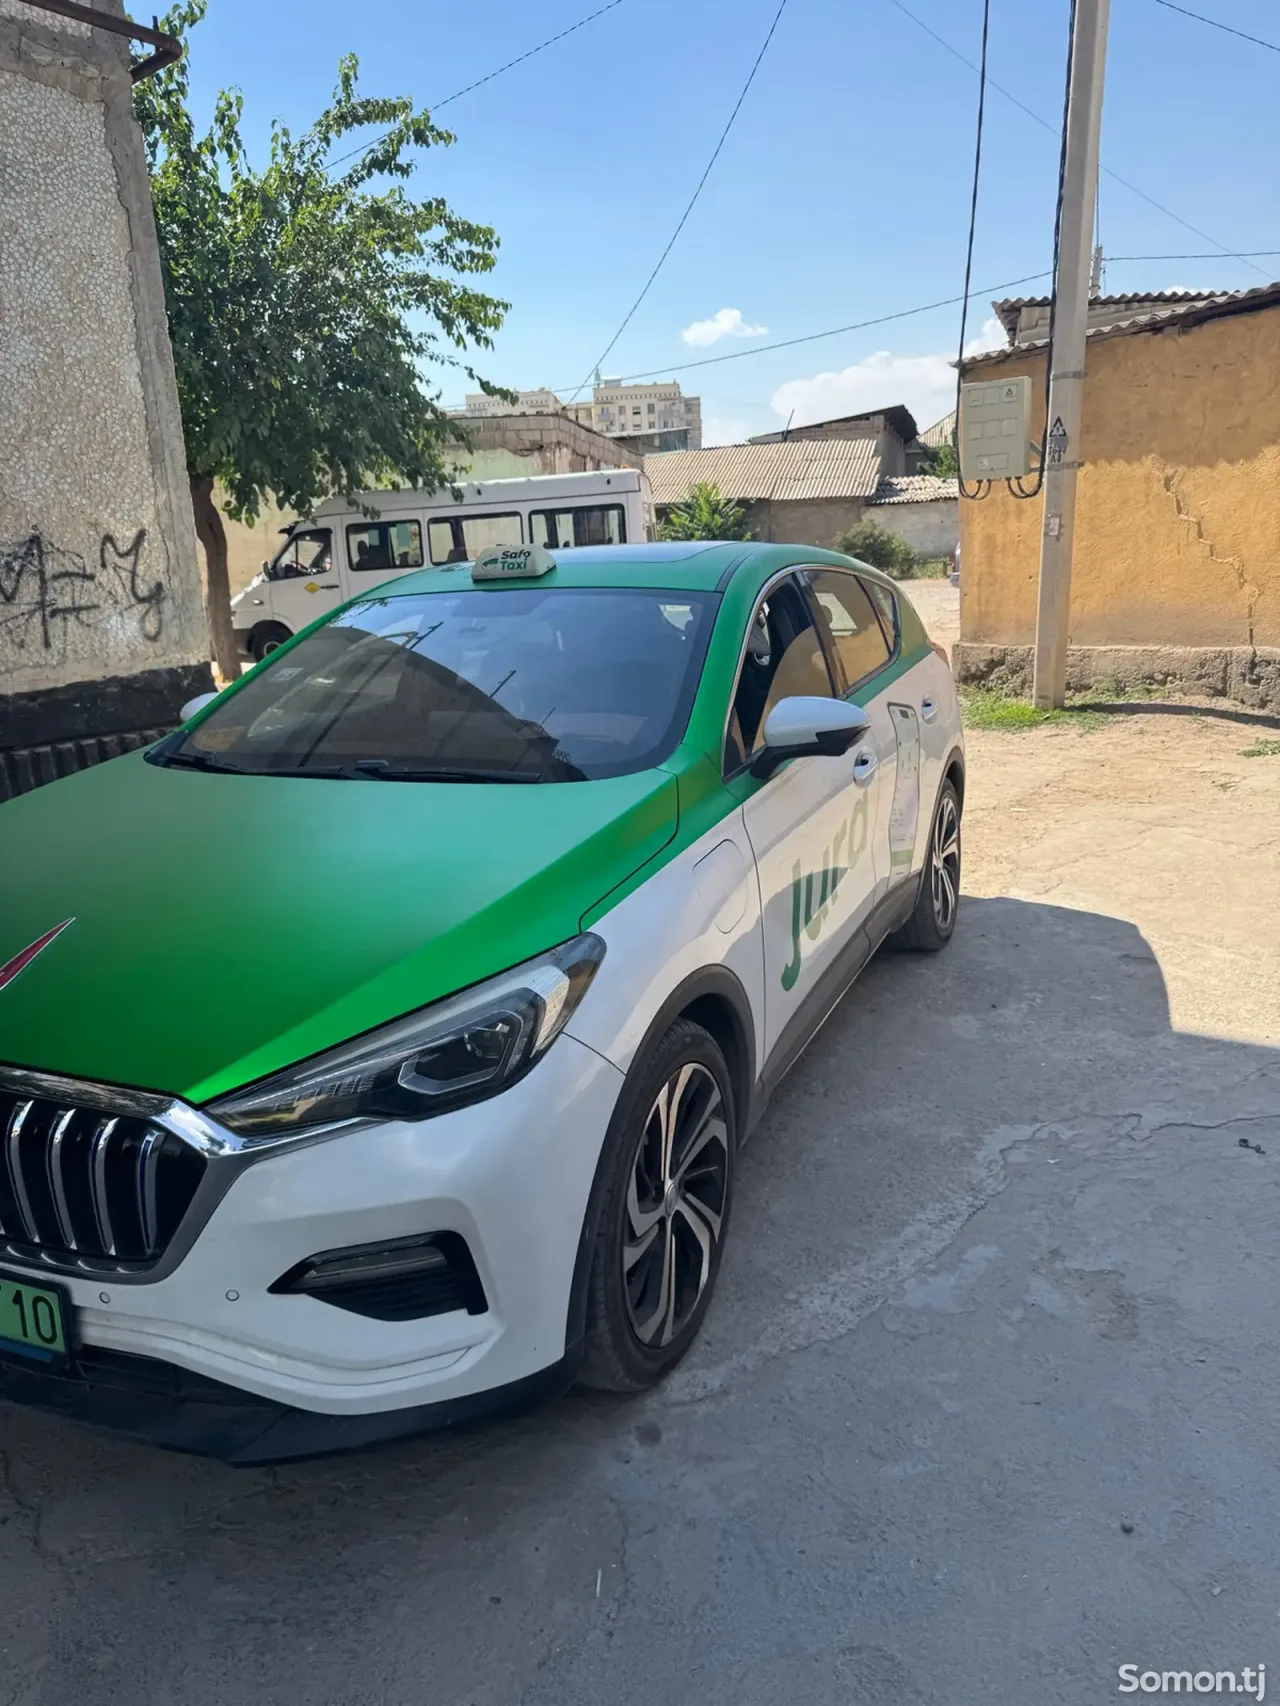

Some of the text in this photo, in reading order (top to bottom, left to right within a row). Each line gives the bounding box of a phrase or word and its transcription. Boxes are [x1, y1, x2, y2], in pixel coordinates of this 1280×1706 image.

[500, 549, 531, 560] Safo
[500, 558, 527, 571] Taxi
[781, 787, 869, 992] Jura
[12, 1289, 57, 1345] 10
